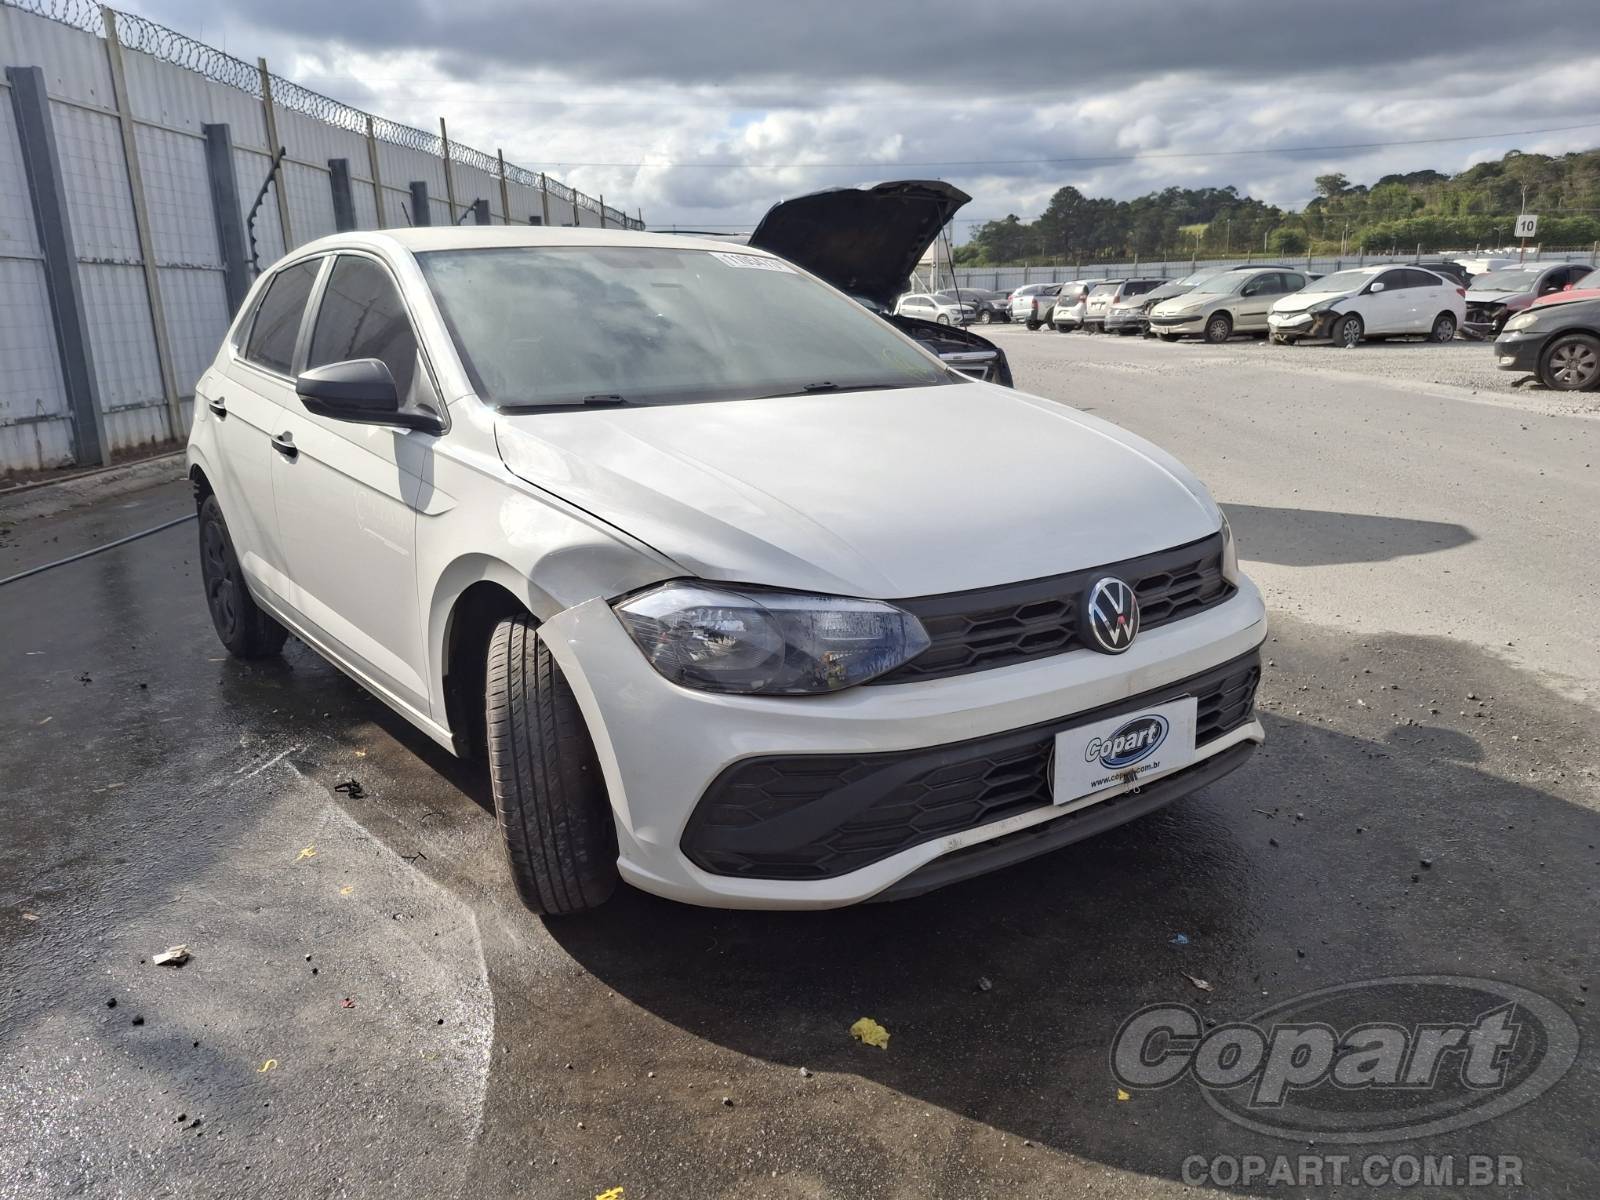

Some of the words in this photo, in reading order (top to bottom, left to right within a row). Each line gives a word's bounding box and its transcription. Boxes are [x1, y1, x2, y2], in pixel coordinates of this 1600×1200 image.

[1520, 220, 1534, 232] 10
[1085, 720, 1160, 762] Copart
[1091, 761, 1160, 788] www.copcom.br
